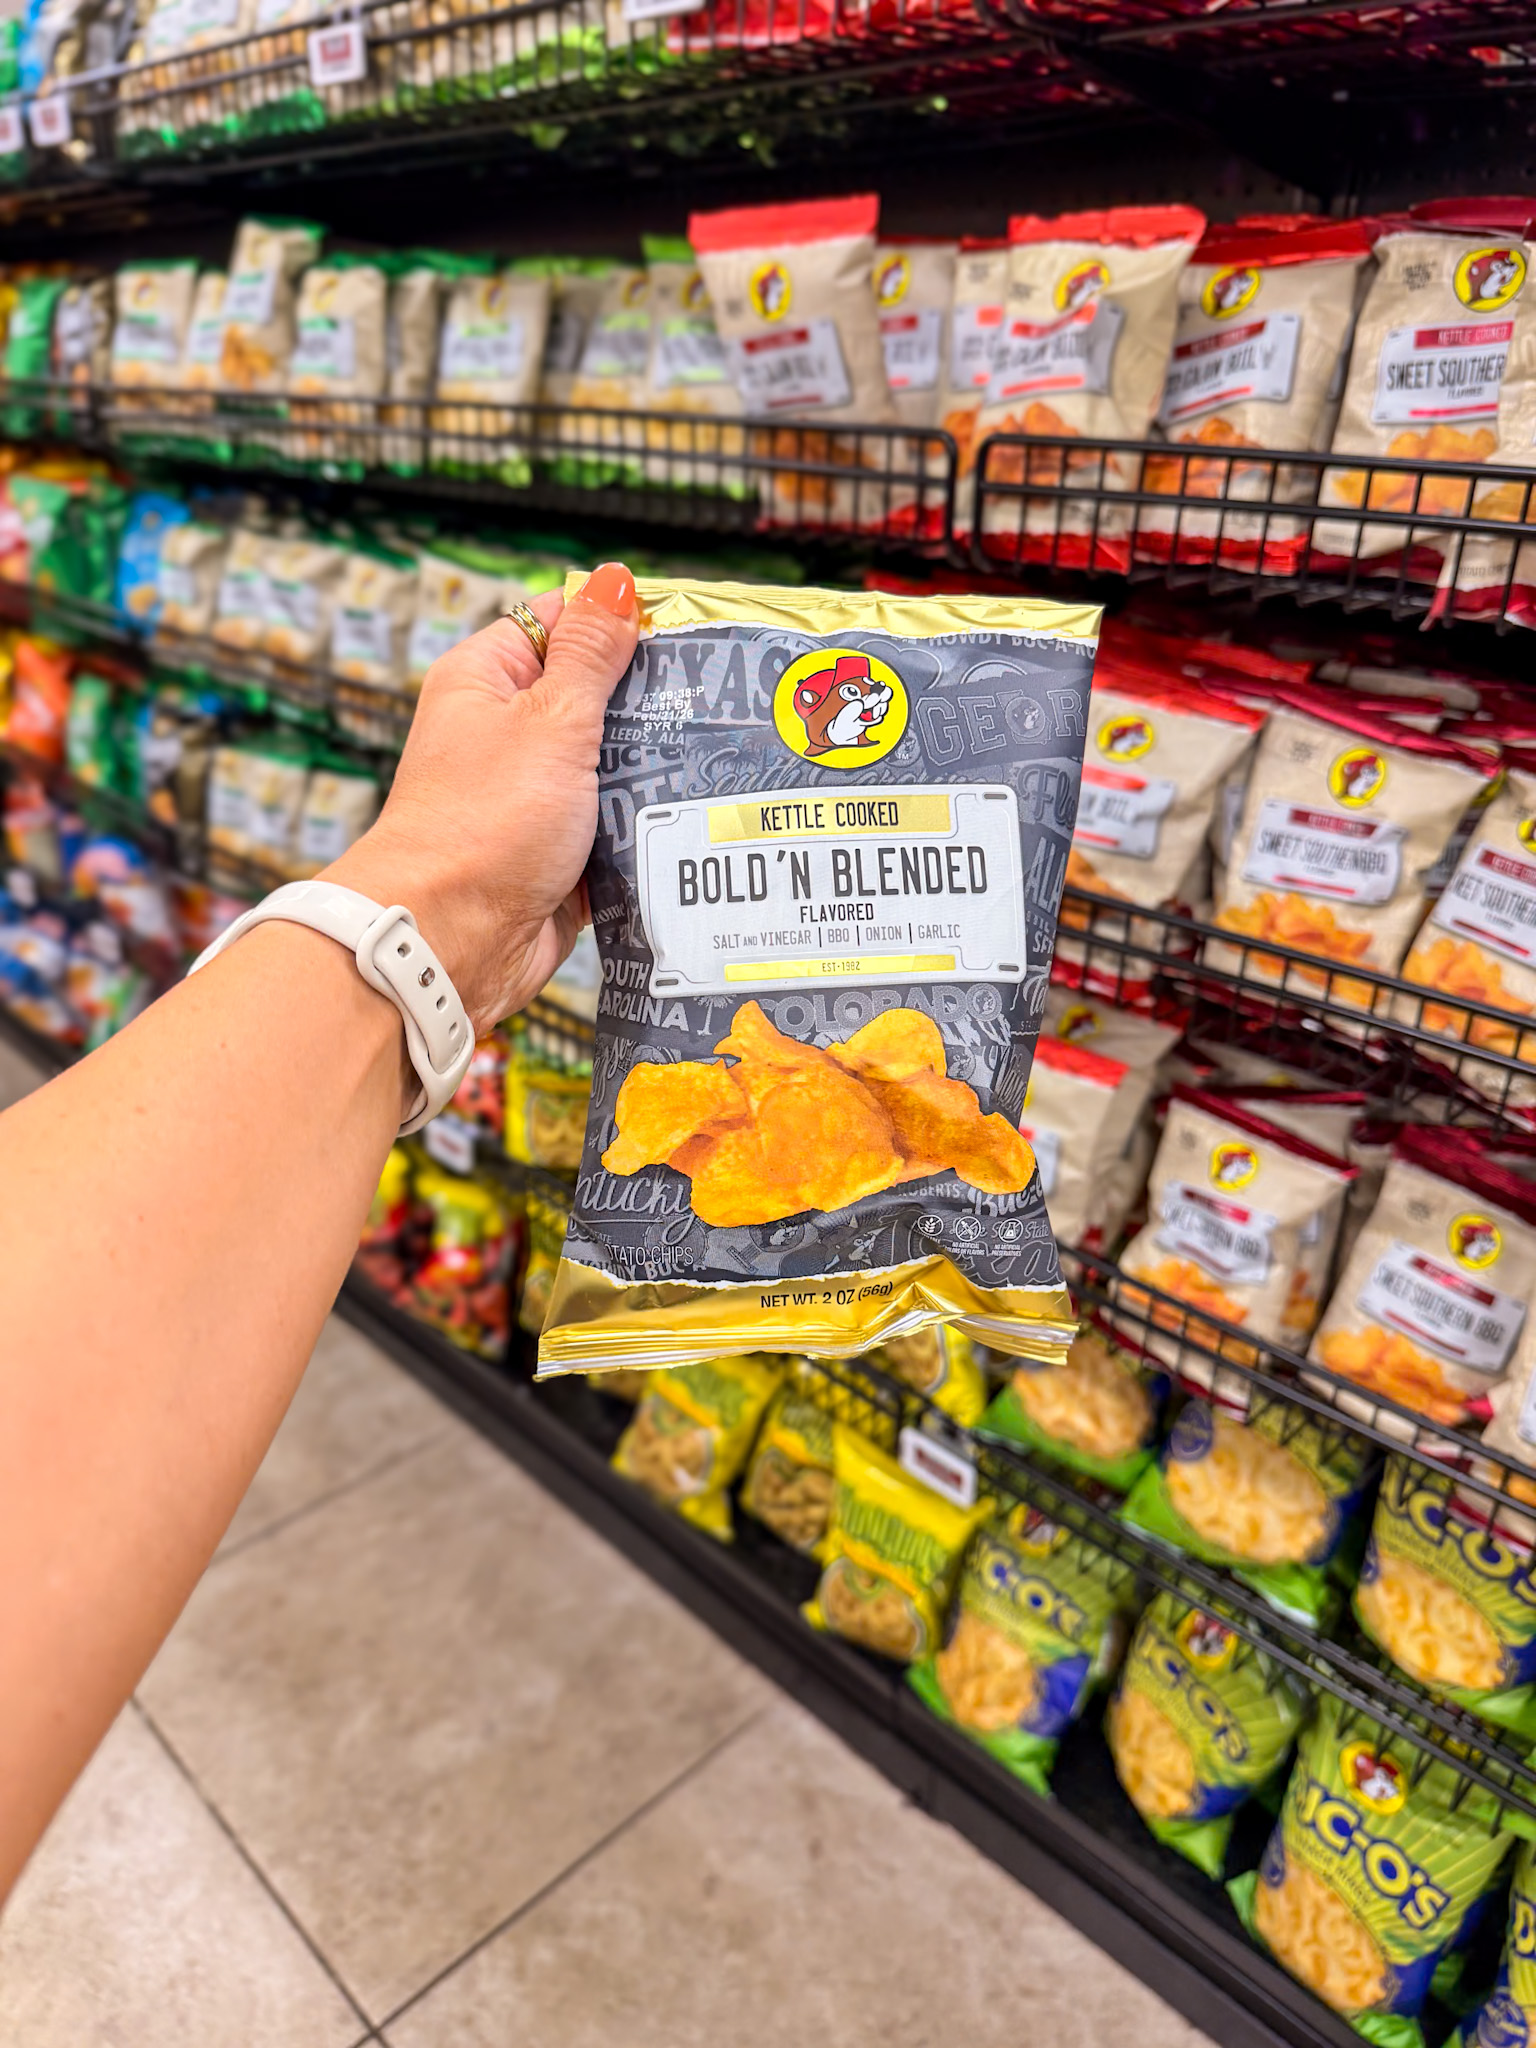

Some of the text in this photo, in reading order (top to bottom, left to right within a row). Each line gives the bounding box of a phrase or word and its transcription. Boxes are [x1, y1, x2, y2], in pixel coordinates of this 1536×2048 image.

[606, 642, 792, 721] TEXAS
[632, 708, 694, 721] Feb/21/26
[642, 698, 692, 712] Best By
[643, 721, 672, 732] SYR
[658, 731, 685, 745] ALA
[761, 801, 899, 832] KETTLE COOKED
[678, 846, 988, 906] BOLD 'N BLENDED
[800, 903, 874, 923] FLAVORED
[713, 924, 961, 949] SALT AND VINEGAR BBQ ONION GARLIC
[651, 1245, 694, 1265] CHIPS
[761, 1281, 893, 1308] NET WT. 2 OZ (56g)
